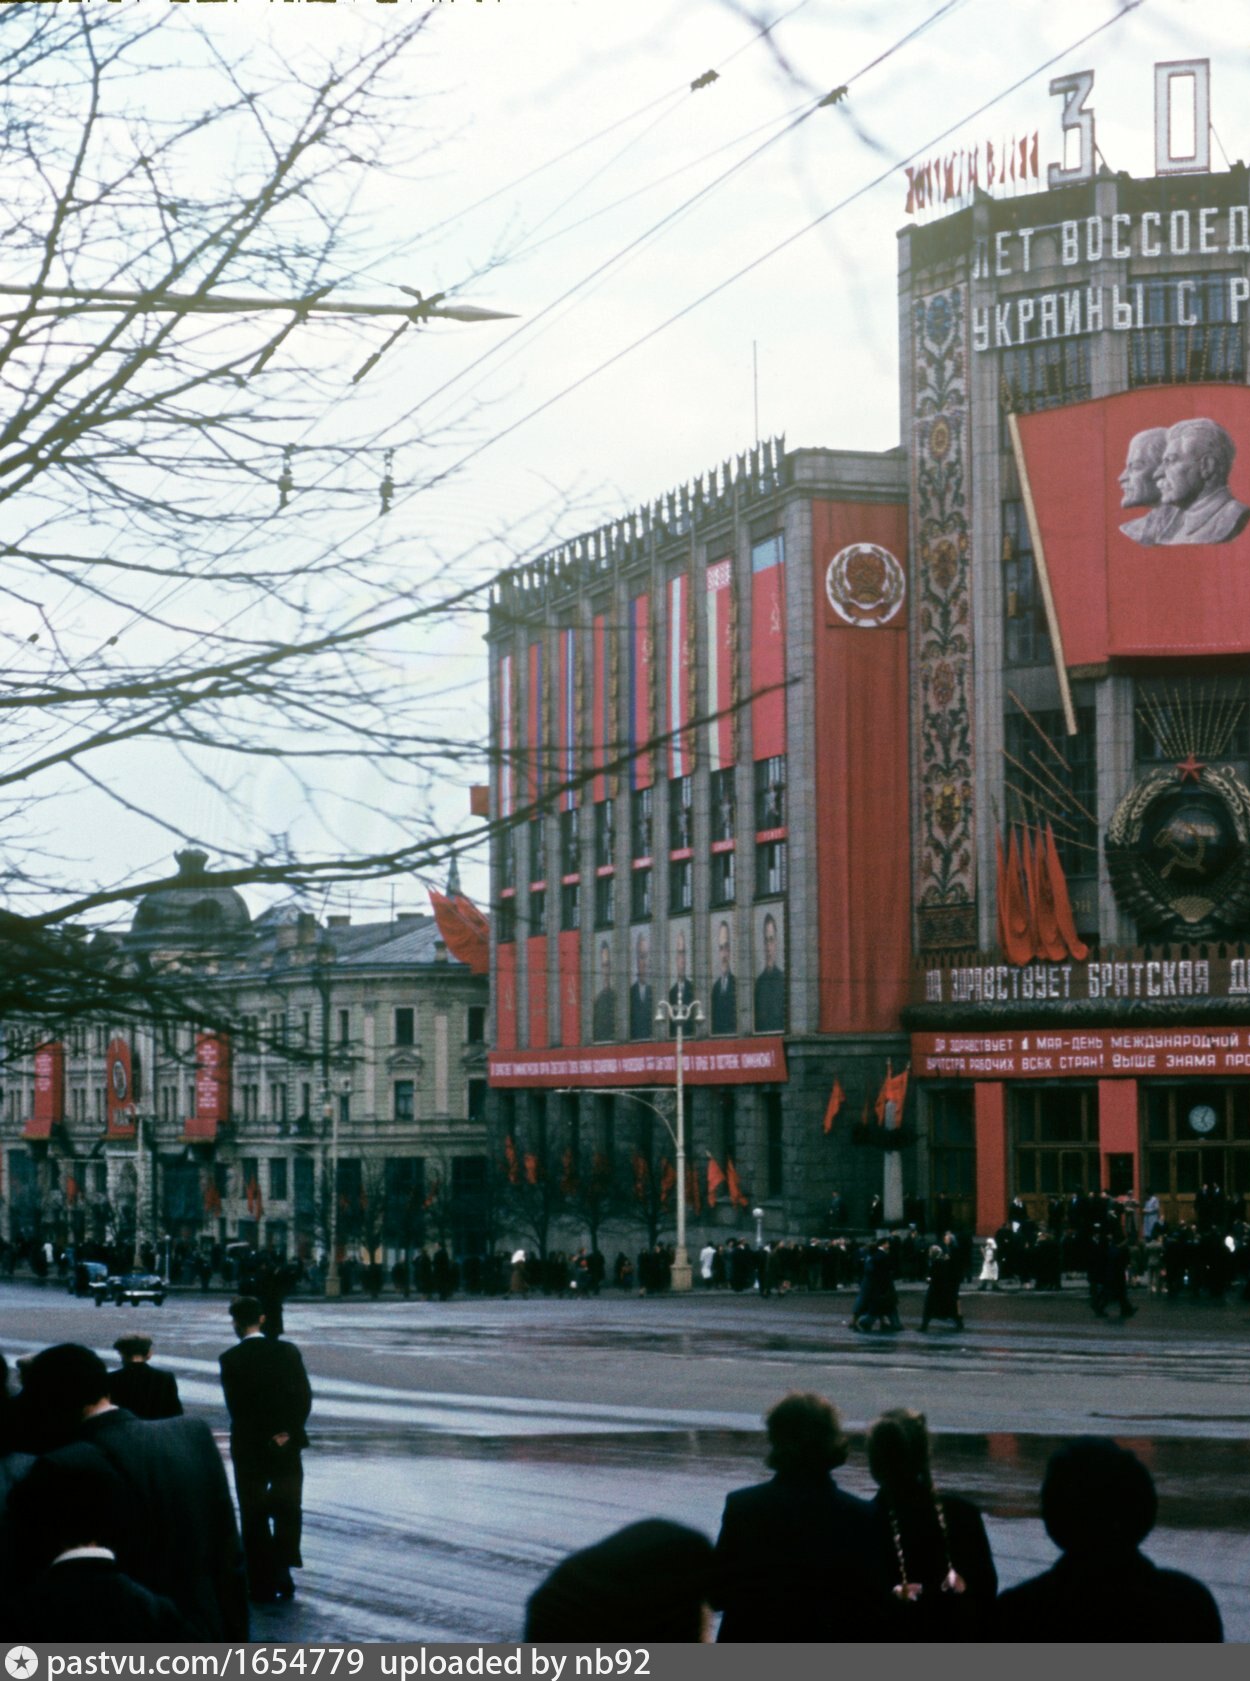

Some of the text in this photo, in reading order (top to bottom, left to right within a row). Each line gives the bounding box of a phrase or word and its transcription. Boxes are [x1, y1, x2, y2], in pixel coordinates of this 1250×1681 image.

[971, 227, 1035, 279] ЛЕТ
[972, 283, 1144, 352] УКРАИНЫ
[1177, 280, 1198, 326] С
[926, 969, 943, 1002] ДА
[951, 963, 1072, 1001] ЗДРАВСТВУЕТ
[1088, 959, 1210, 998] БРАТСКАЯ
[950, 1038, 1014, 1053] ЗДРАВСТВУЕТ
[1111, 1032, 1239, 1050] МЕЖДУНАРОДНОЙ
[969, 1057, 1015, 1070] РАБОЧИХ
[1022, 1056, 1052, 1070] ВСЕХ
[1059, 1053, 1104, 1069] СТРАН!
[1112, 1053, 1156, 1068] ВЫШЕ
[1166, 1052, 1216, 1068] ЗНАМЯ
